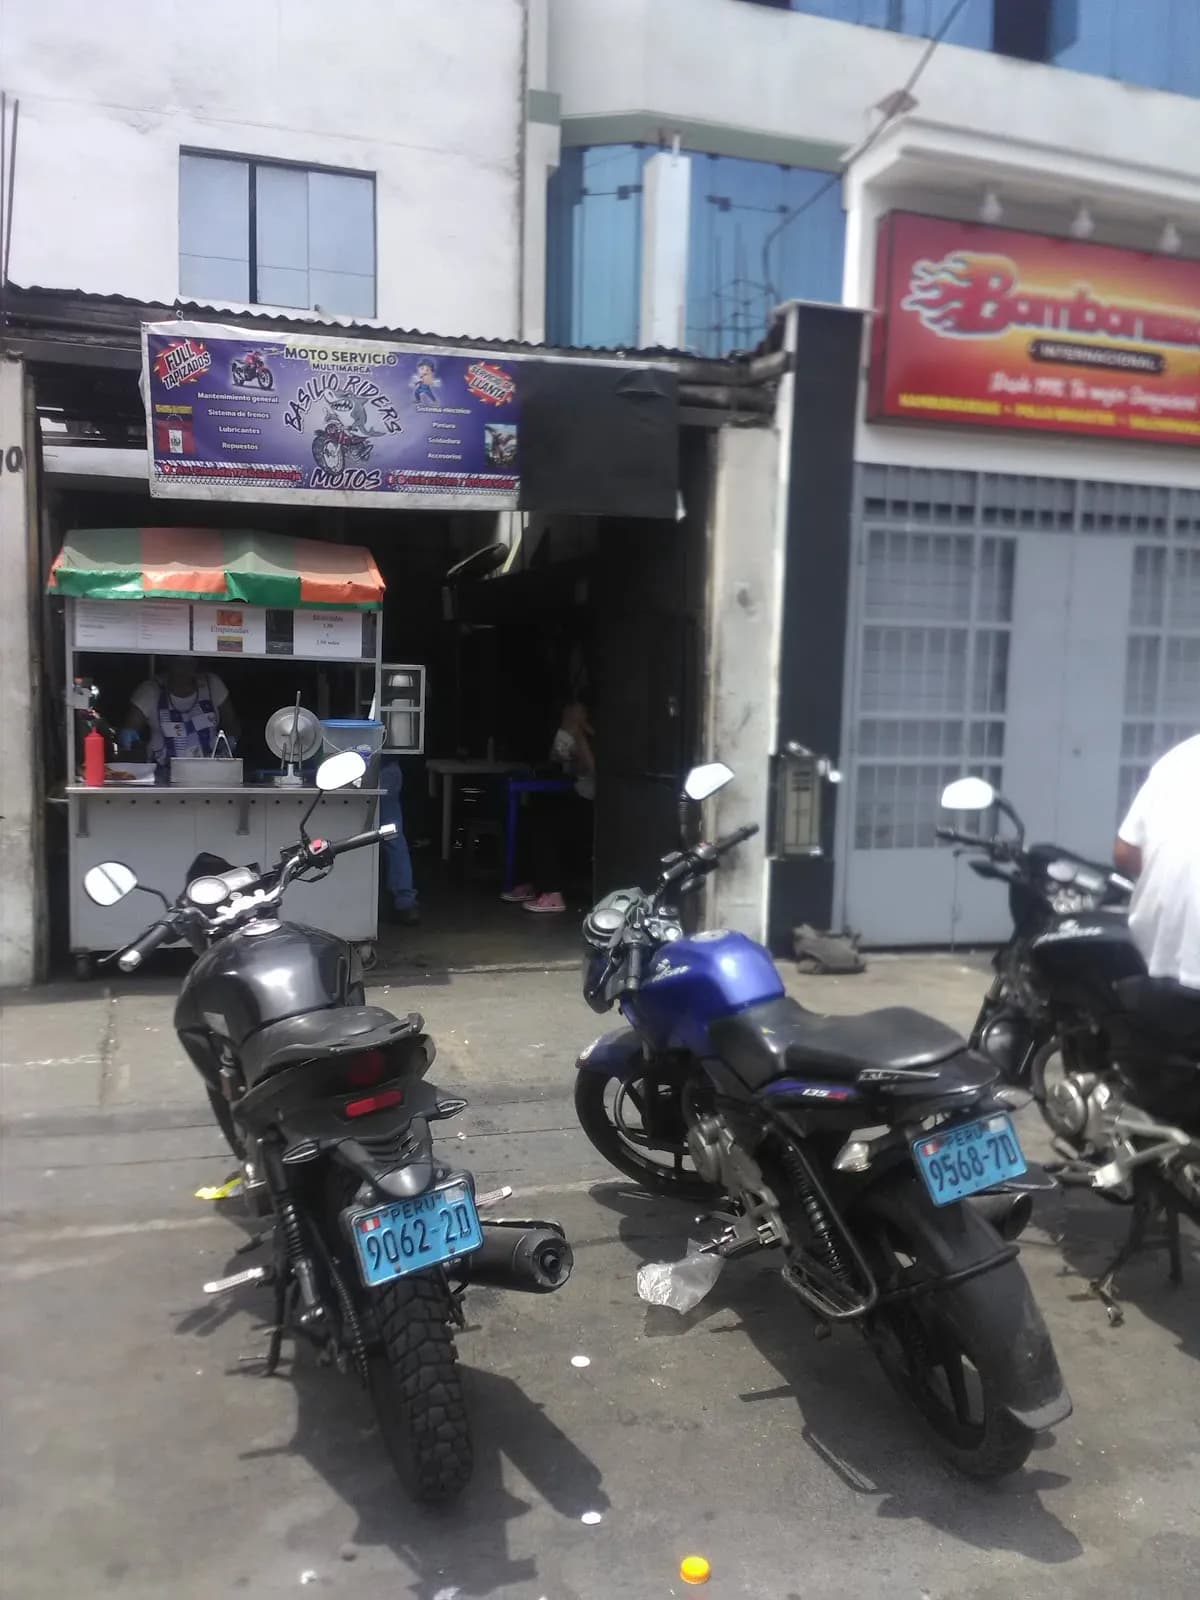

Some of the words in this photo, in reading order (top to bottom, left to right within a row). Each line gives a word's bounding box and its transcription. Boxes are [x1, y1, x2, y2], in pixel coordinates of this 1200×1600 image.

[164, 343, 196, 371] FULL
[285, 347, 328, 360] MOTO
[332, 351, 397, 365] SERVICIO
[163, 351, 211, 387] TAPIZADOS
[312, 363, 371, 373] MULTIMARCA
[197, 392, 251, 402] Mantenimiento
[252, 396, 279, 404] general
[284, 373, 339, 432] BASILIO
[344, 375, 402, 433] RIDERS
[208, 409, 237, 417] Sistema
[219, 426, 260, 434] Lubricantes
[222, 442, 258, 450] Repuestos
[0, 446, 23, 476] 0
[310, 469, 380, 489] MOTOS
[928, 1133, 1019, 1192] 9568-7D
[389, 1196, 437, 1222] PERU
[365, 1203, 472, 1271] 9062-2D
